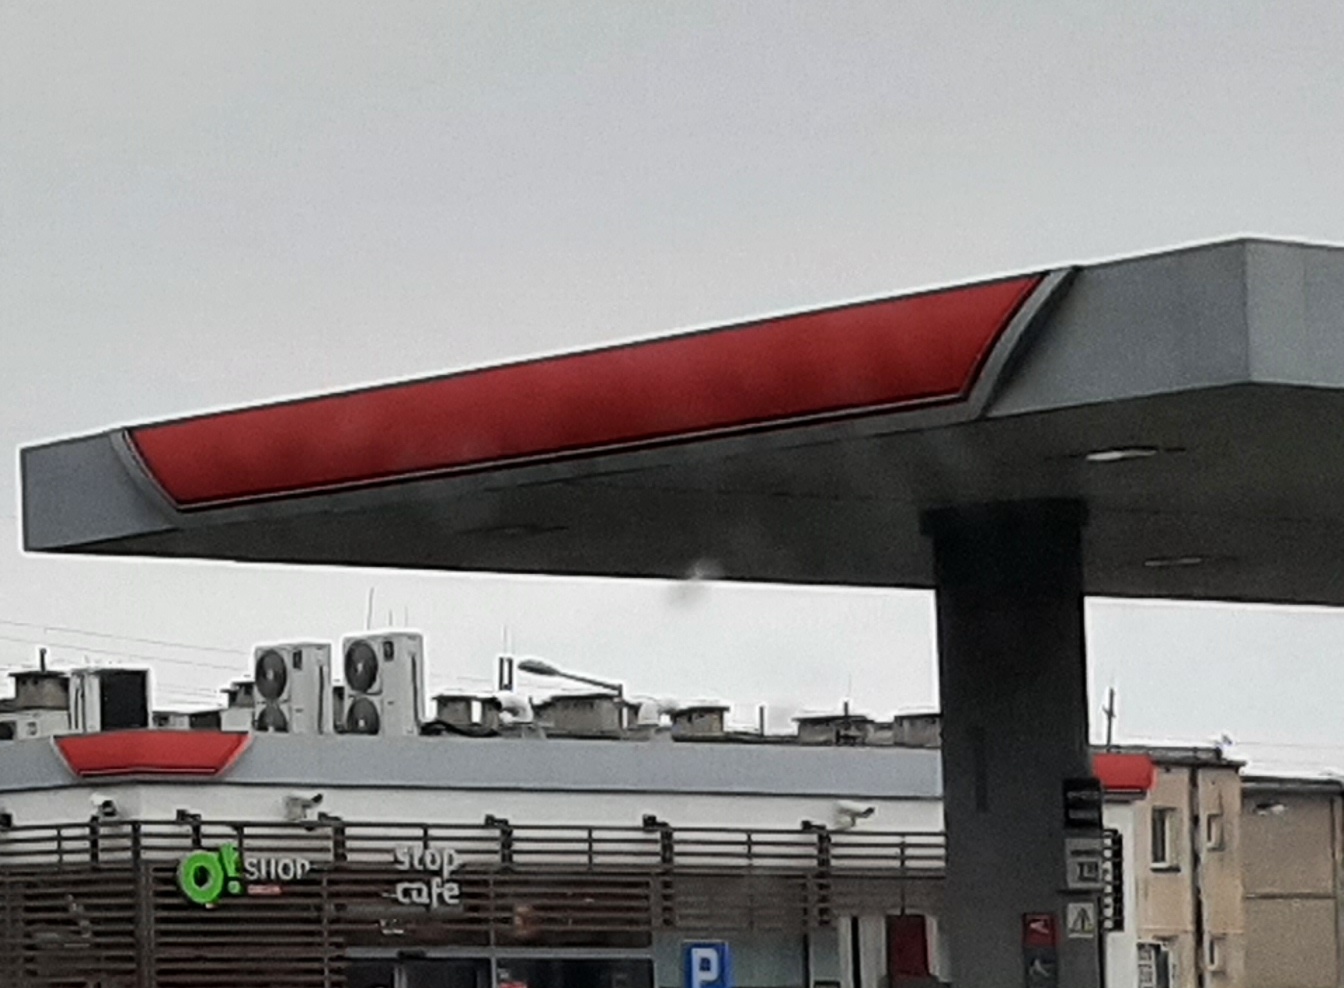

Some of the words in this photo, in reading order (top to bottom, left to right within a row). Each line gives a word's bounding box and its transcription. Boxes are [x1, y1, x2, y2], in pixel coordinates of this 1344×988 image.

[244, 857, 311, 880] SHOP
[395, 846, 459, 880] stop
[395, 877, 461, 908] cafe
